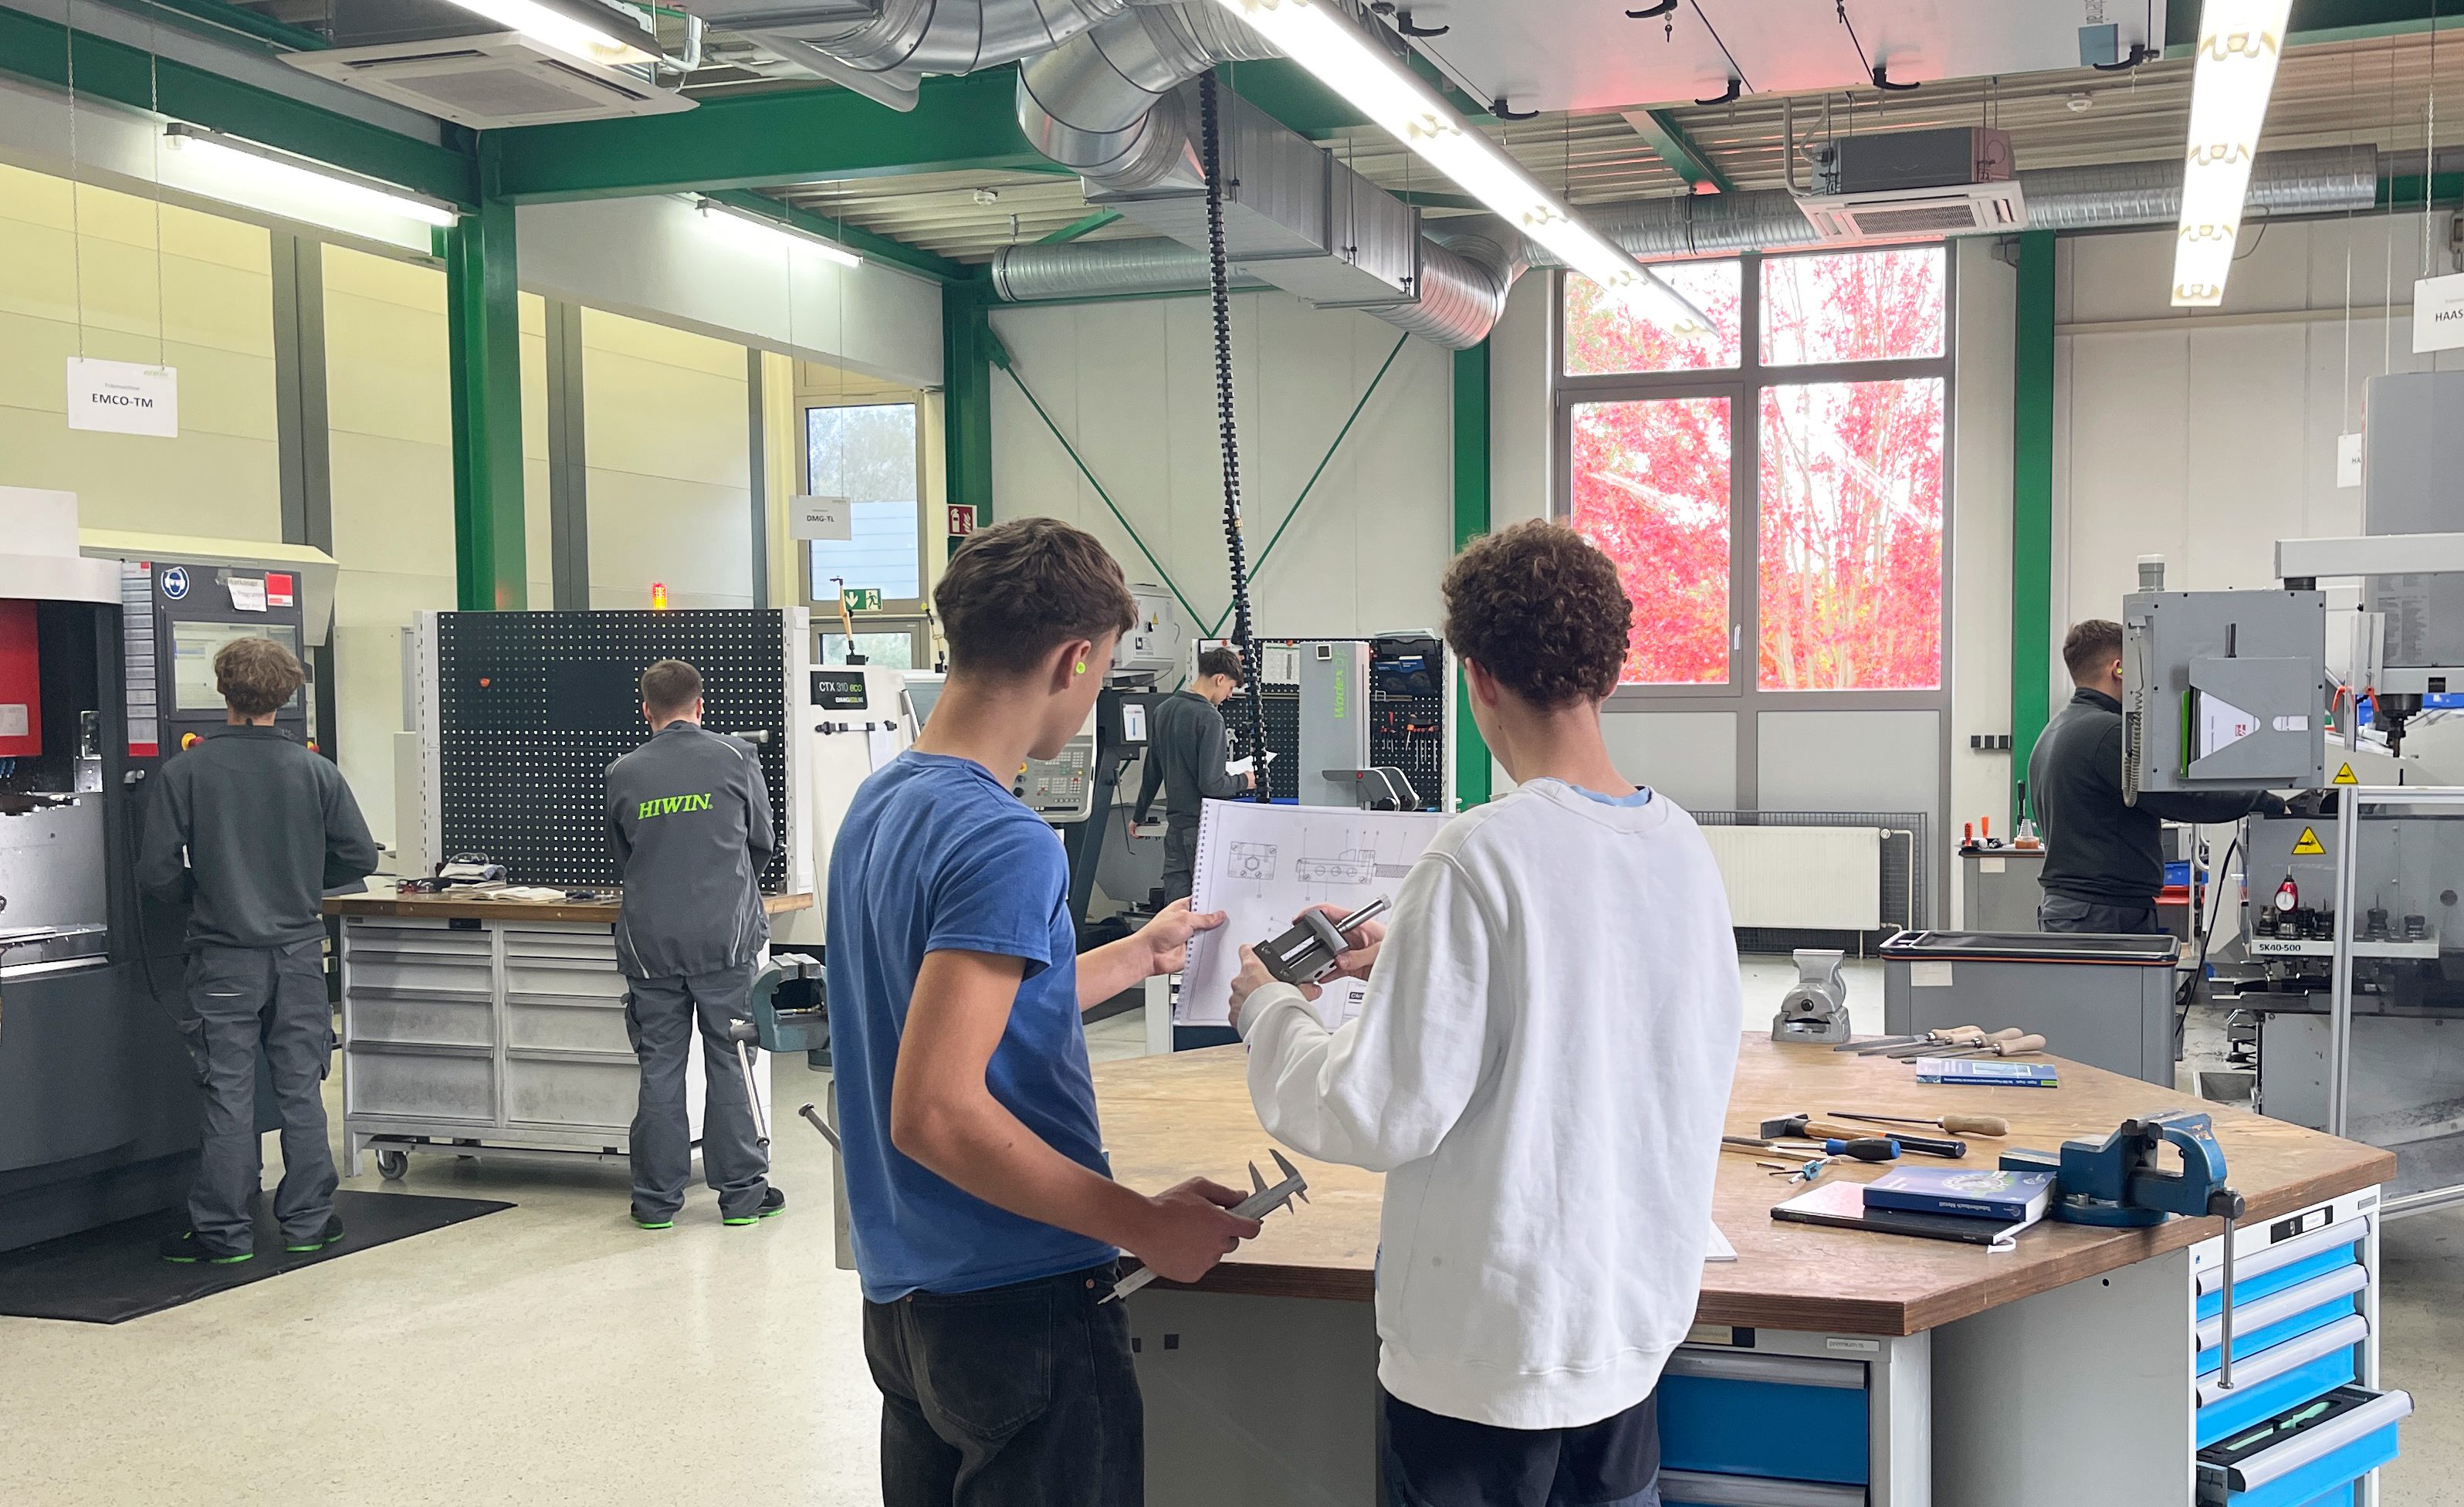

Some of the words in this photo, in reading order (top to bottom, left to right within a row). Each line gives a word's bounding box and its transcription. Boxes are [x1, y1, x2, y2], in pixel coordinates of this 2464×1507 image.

[92, 393, 154, 408] EMCO-TM
[819, 682, 836, 693] CTX
[836, 682, 849, 693] 310
[849, 684, 863, 693] eco
[2259, 943, 2301, 952] SK40-500
